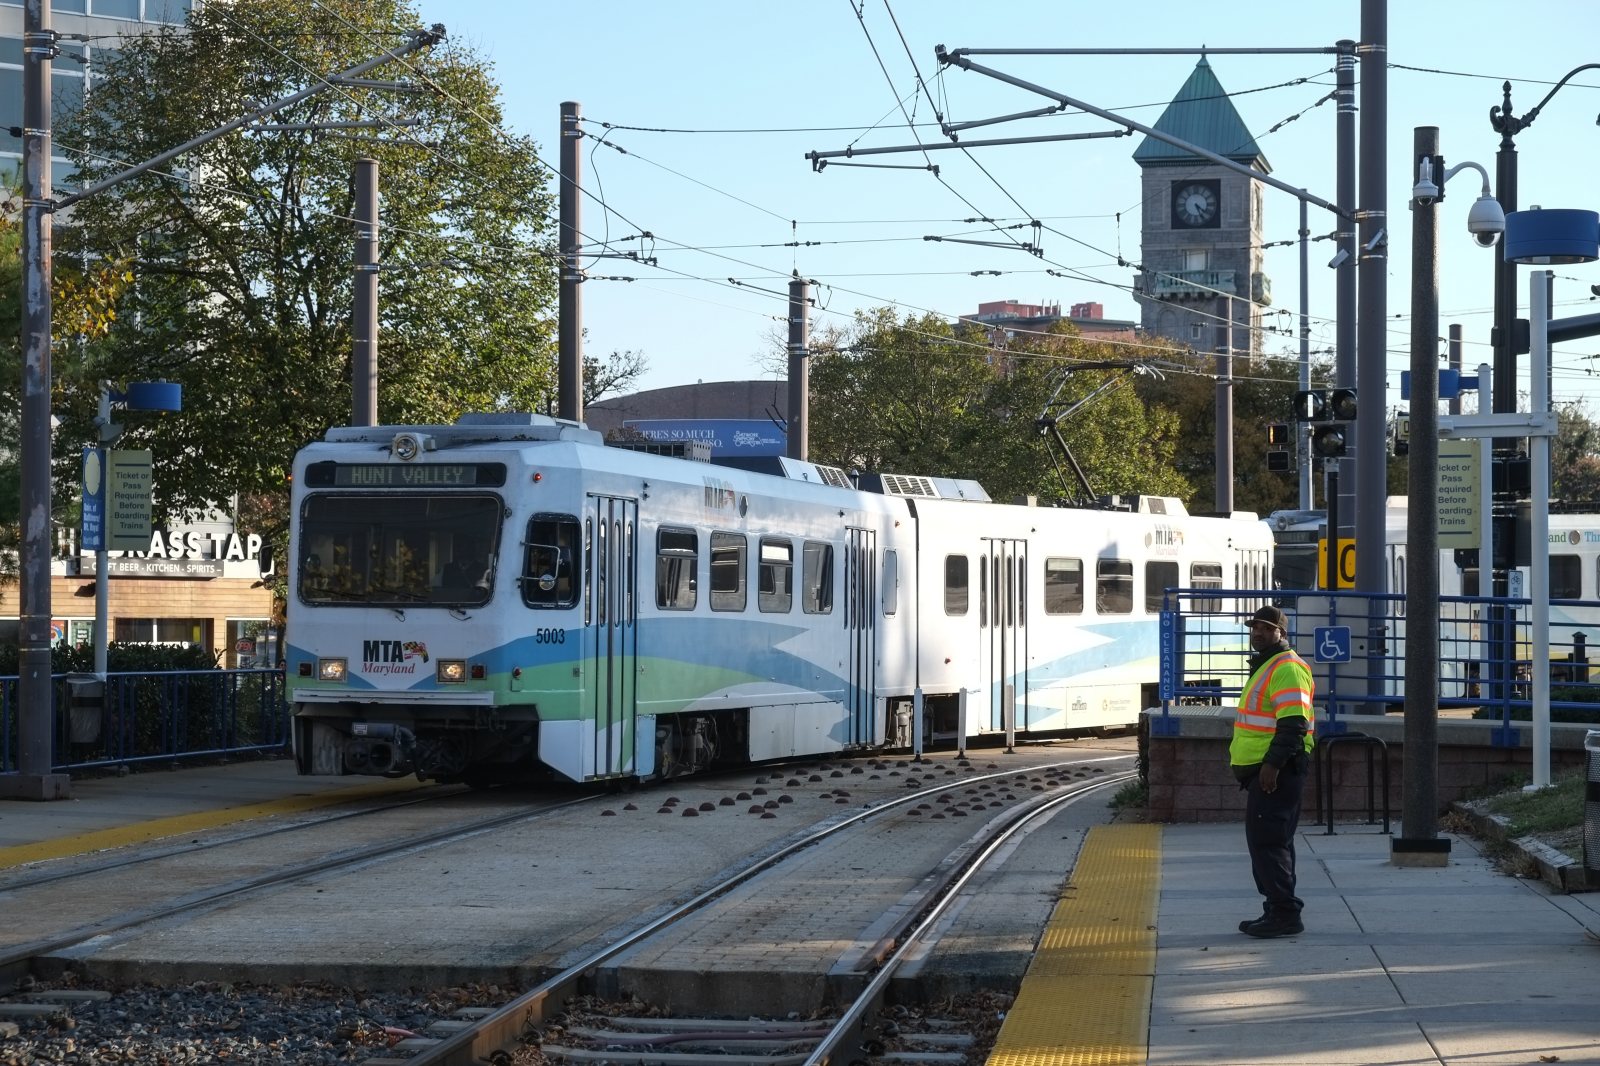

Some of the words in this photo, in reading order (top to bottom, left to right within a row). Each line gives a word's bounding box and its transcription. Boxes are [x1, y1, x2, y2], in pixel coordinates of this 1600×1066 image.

[686, 430, 714, 439] MUCH
[1438, 464, 1459, 472] icket
[115, 471, 139, 480] Ticket
[140, 472, 149, 480] or
[351, 466, 393, 484] HUNT
[401, 466, 465, 484] VALLEY
[1438, 485, 1472, 495] equired
[114, 492, 150, 500] Required
[1438, 496, 1467, 504] Before
[1438, 507, 1473, 516] oarding
[114, 512, 150, 521] Boarding
[1439, 517, 1466, 526] Trains
[211, 533, 262, 561] TAP
[91, 562, 117, 573] CFT
[119, 563, 140, 573] BEER
[146, 564, 180, 573] KITCHEN
[186, 564, 216, 574] SPIRITS
[1163, 613, 1170, 627] NO
[535, 628, 566, 645] 5003
[363, 640, 404, 663] MTA
[361, 662, 415, 676] Maryland
